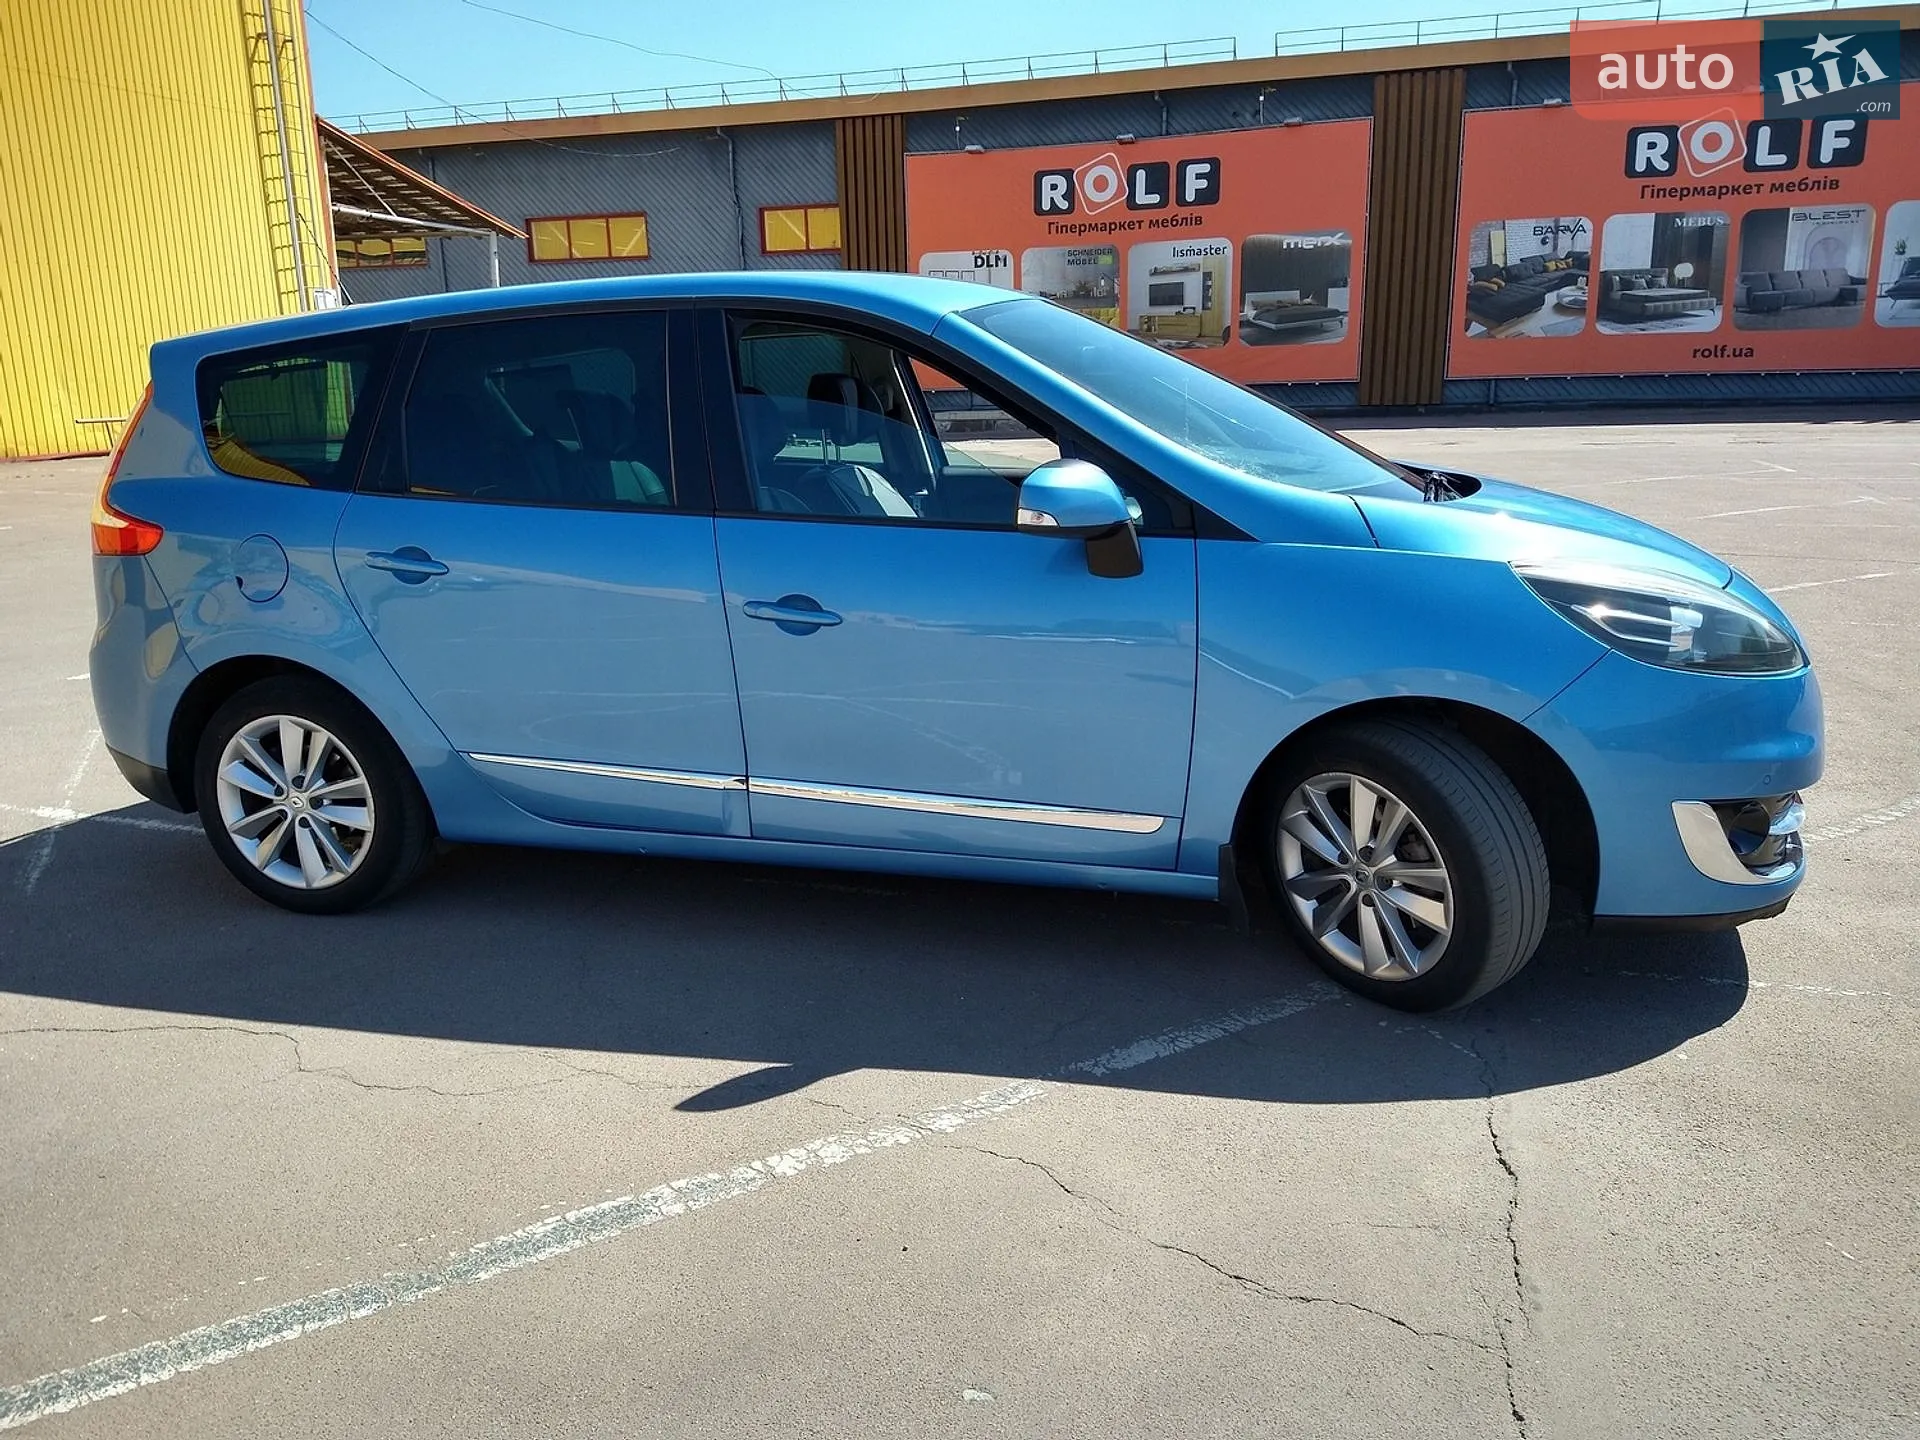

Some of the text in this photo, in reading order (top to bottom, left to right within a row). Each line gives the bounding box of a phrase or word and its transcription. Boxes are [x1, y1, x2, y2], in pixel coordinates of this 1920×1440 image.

[1634, 119, 1857, 173] ROLF
[1041, 163, 1212, 211] ROLF
[1640, 176, 1840, 201] Гіпермаркет меблів
[1047, 212, 1203, 236] Гіпермаркет меблів
[1674, 216, 1725, 228] MEBUS
[1792, 209, 1867, 222] BLEST
[1533, 218, 1587, 240] BARVA
[974, 254, 1007, 268] DLM
[1692, 344, 1754, 358] rolf.ua
